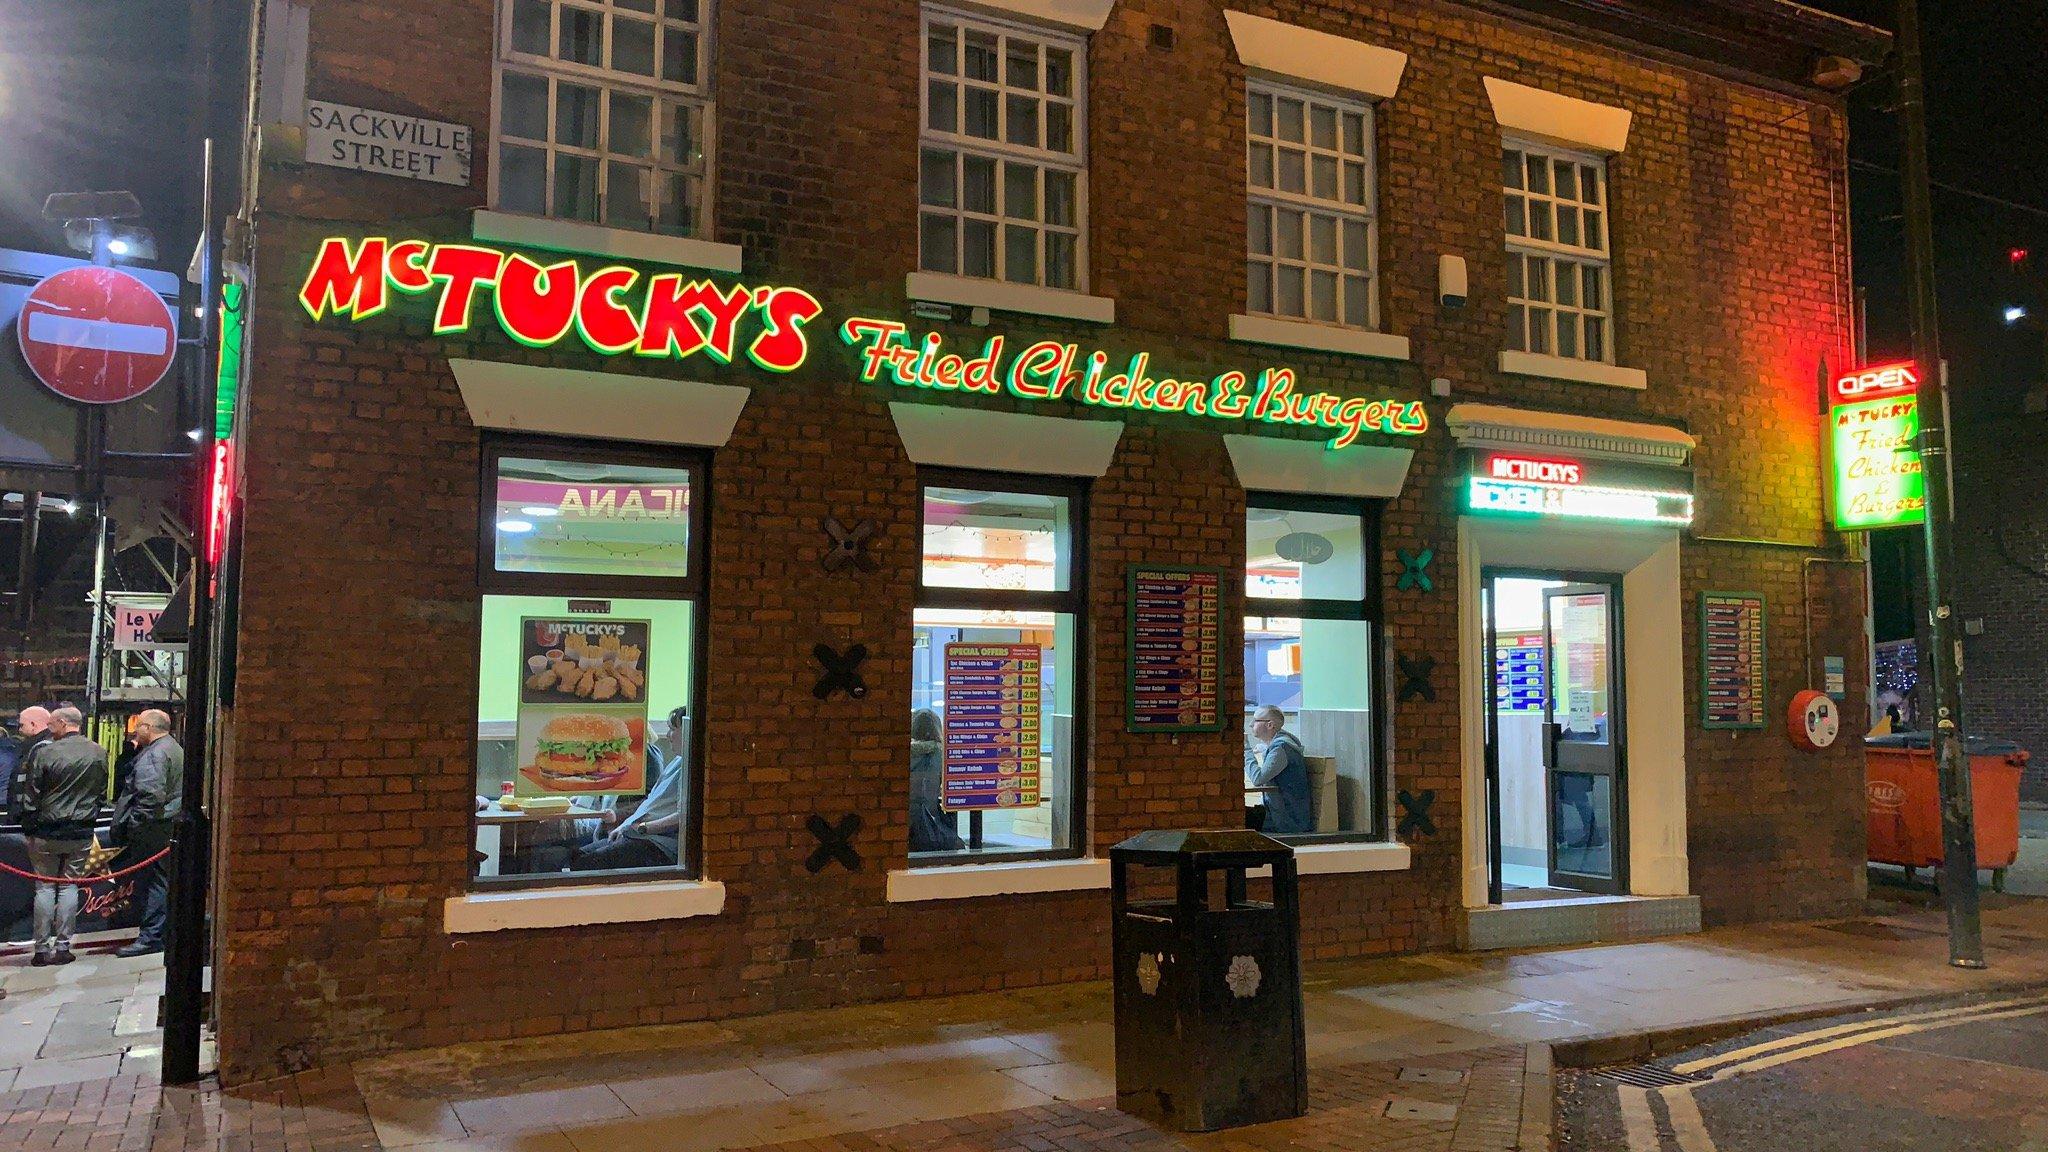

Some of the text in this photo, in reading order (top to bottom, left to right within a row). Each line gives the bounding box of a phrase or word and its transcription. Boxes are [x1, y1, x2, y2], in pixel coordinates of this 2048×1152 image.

[309, 107, 465, 151] SACKVILLE
[332, 139, 441, 175] STREET
[840, 316, 1428, 450] Fried Chicken & Burgers
[1853, 425, 1911, 450] Fried
[1492, 458, 1579, 483] MCTUCKYS
[1848, 455, 1922, 479] Chicken
[1848, 493, 1924, 518] Burgers
[1137, 572, 1164, 580] SPECIAL
[1165, 573, 1190, 581] OFFERS
[127, 612, 144, 626] Le
[949, 648, 980, 656] SPECIAL
[981, 648, 1009, 656] OFFERS
